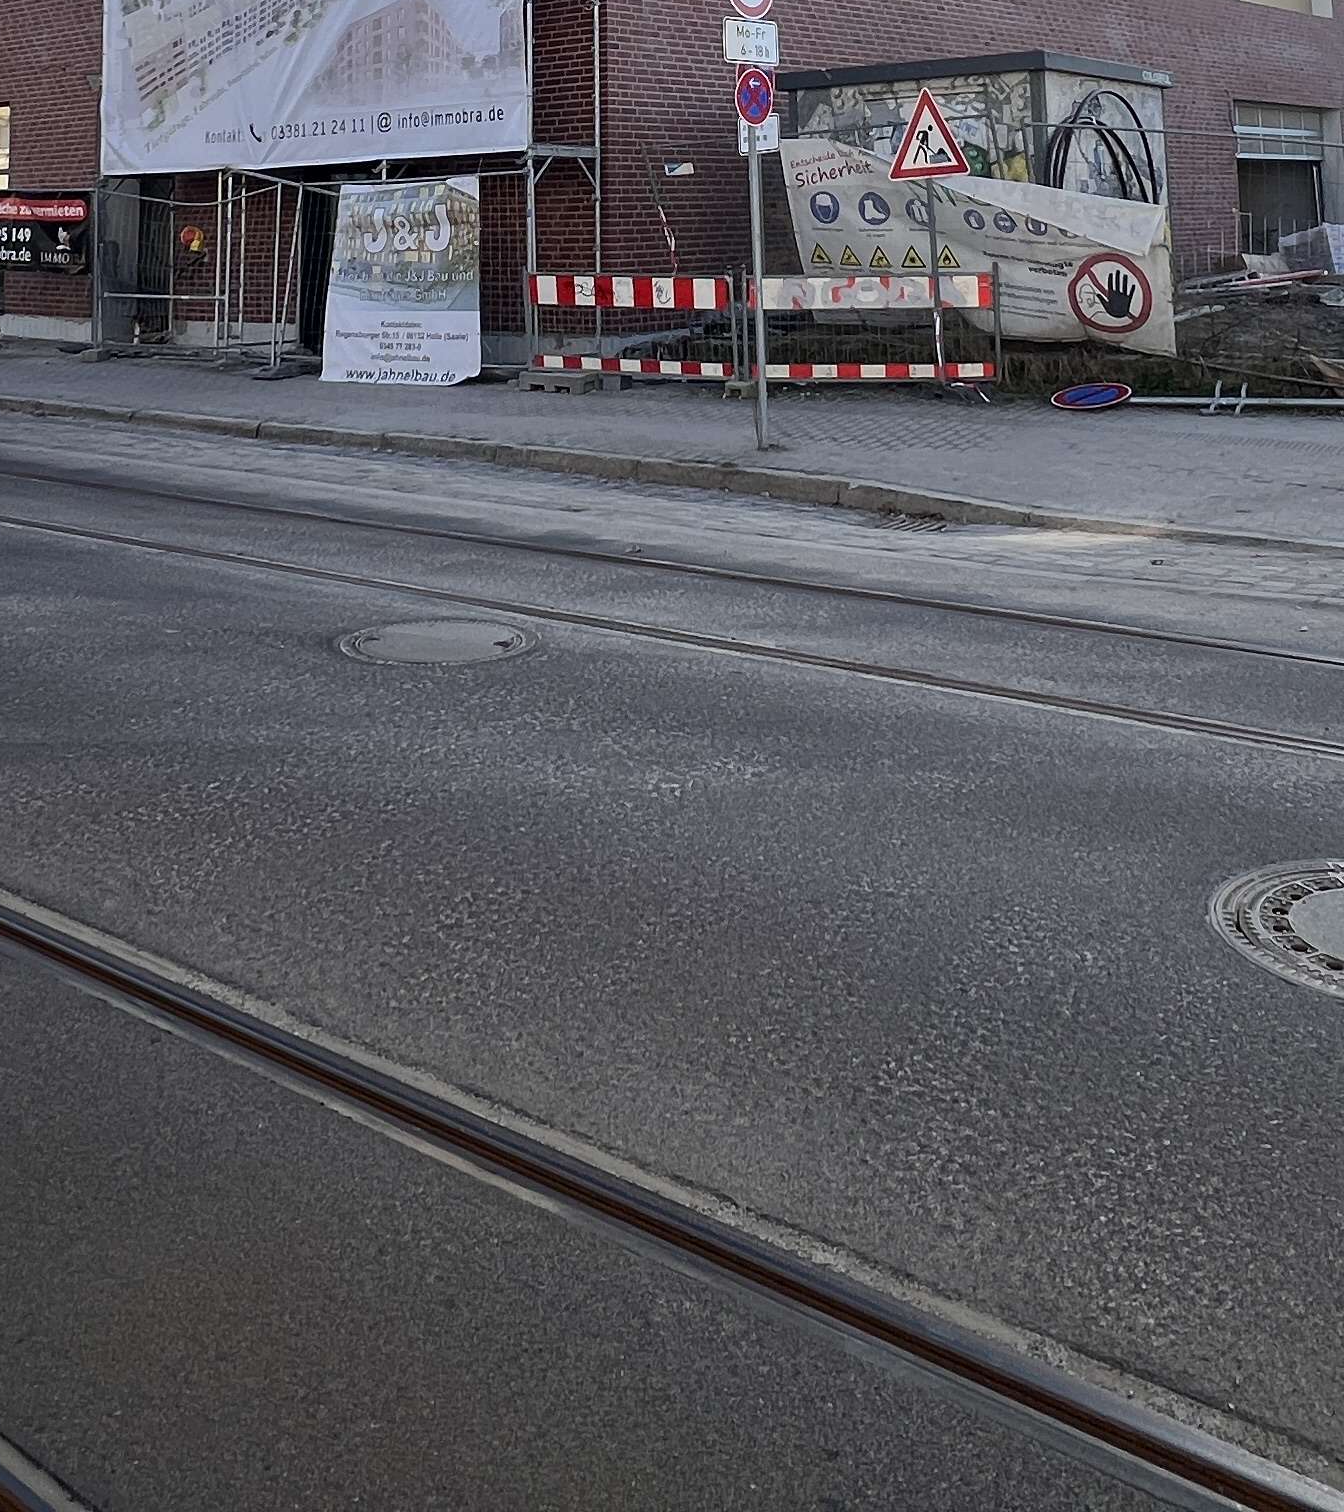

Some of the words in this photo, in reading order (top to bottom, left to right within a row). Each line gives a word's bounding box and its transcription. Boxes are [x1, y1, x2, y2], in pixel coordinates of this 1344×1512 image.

[736, 25, 766, 41] Mo-Fr
[331, 120, 346, 136] 24
[397, 105, 505, 129] info@immobra.de
[795, 160, 874, 188] Sicherheit
[32, 205, 85, 218] vermieten
[11, 227, 31, 242] 149
